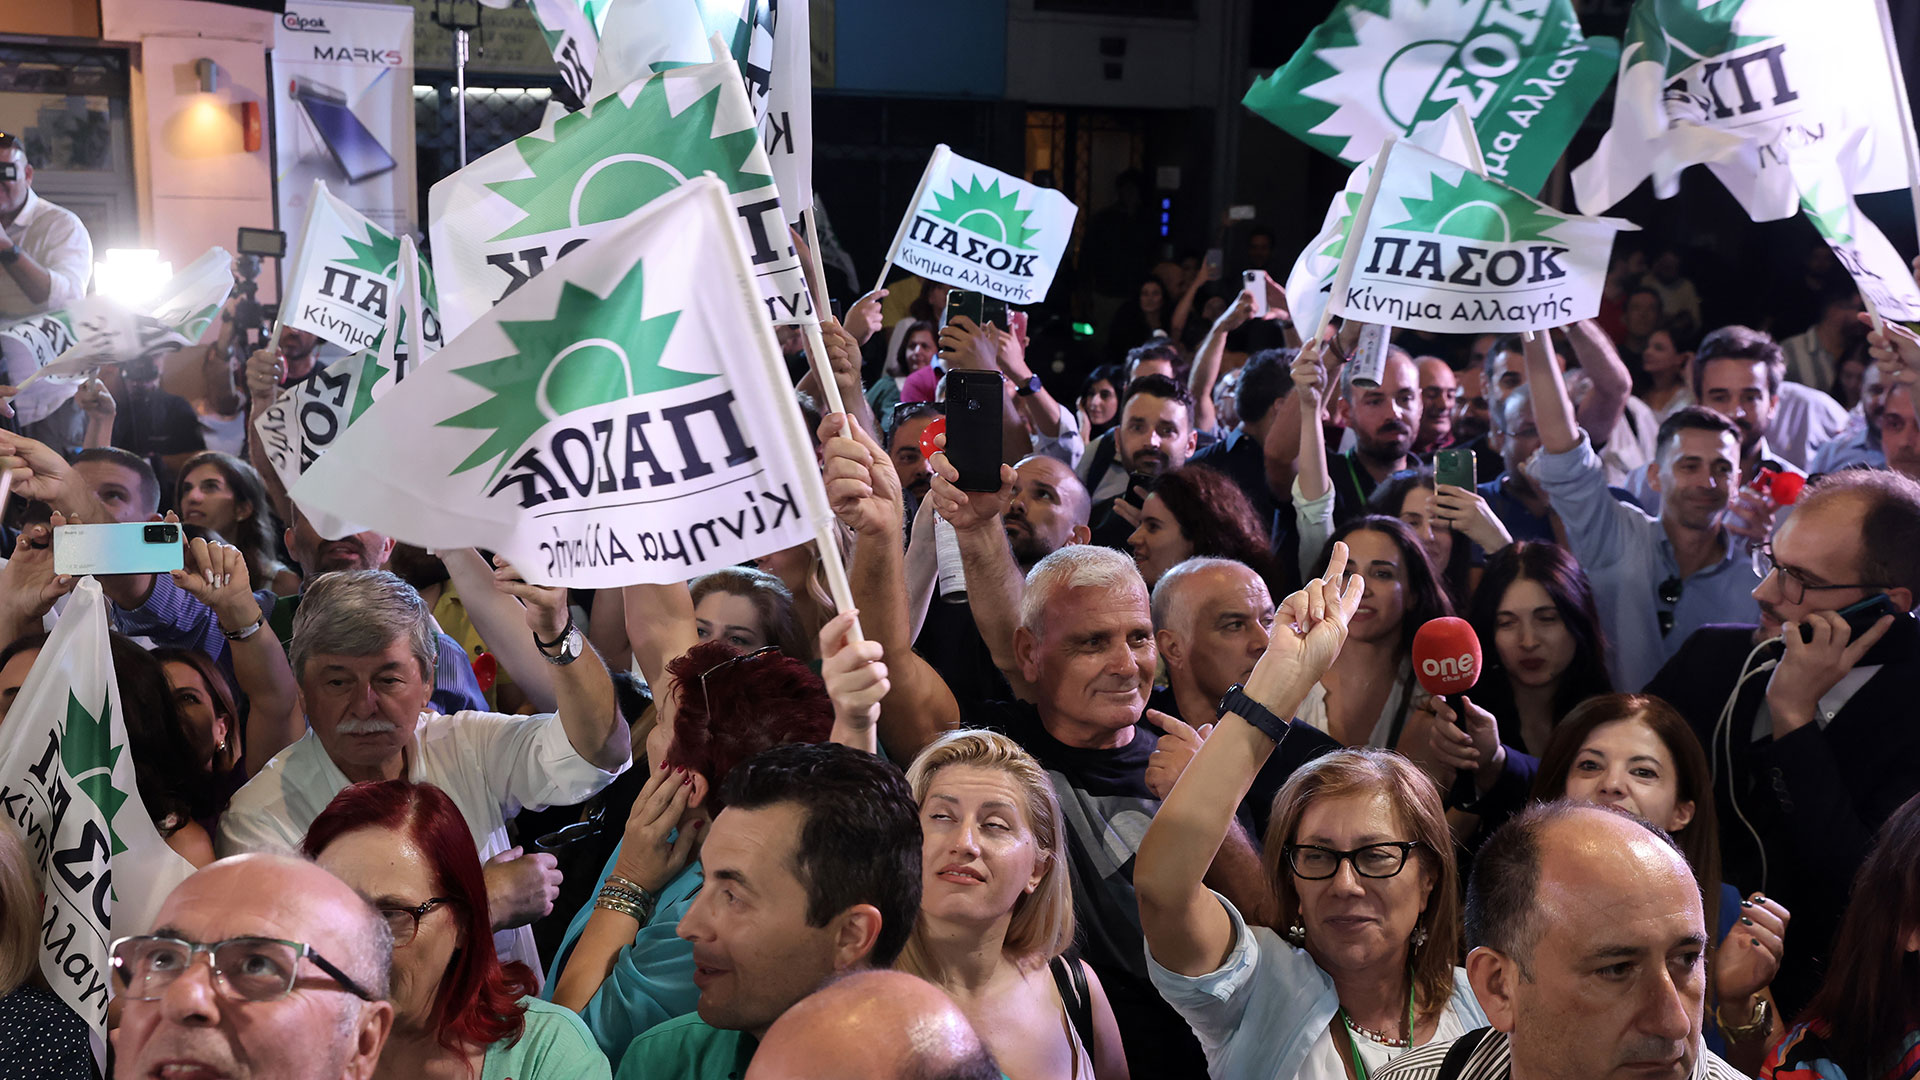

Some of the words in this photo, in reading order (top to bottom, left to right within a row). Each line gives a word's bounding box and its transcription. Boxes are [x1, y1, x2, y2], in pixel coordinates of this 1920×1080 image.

[909, 215, 1039, 277] ΠΑΣΟΚ
[1364, 237, 1569, 287] ΠΑΣΟΚ
[902, 247, 954, 277] Κίνημα
[957, 269, 1033, 300] Αλλαγής
[1345, 287, 1442, 321] Κίνημα
[1450, 293, 1573, 324] Αλλαγής
[1422, 653, 1474, 677] one
